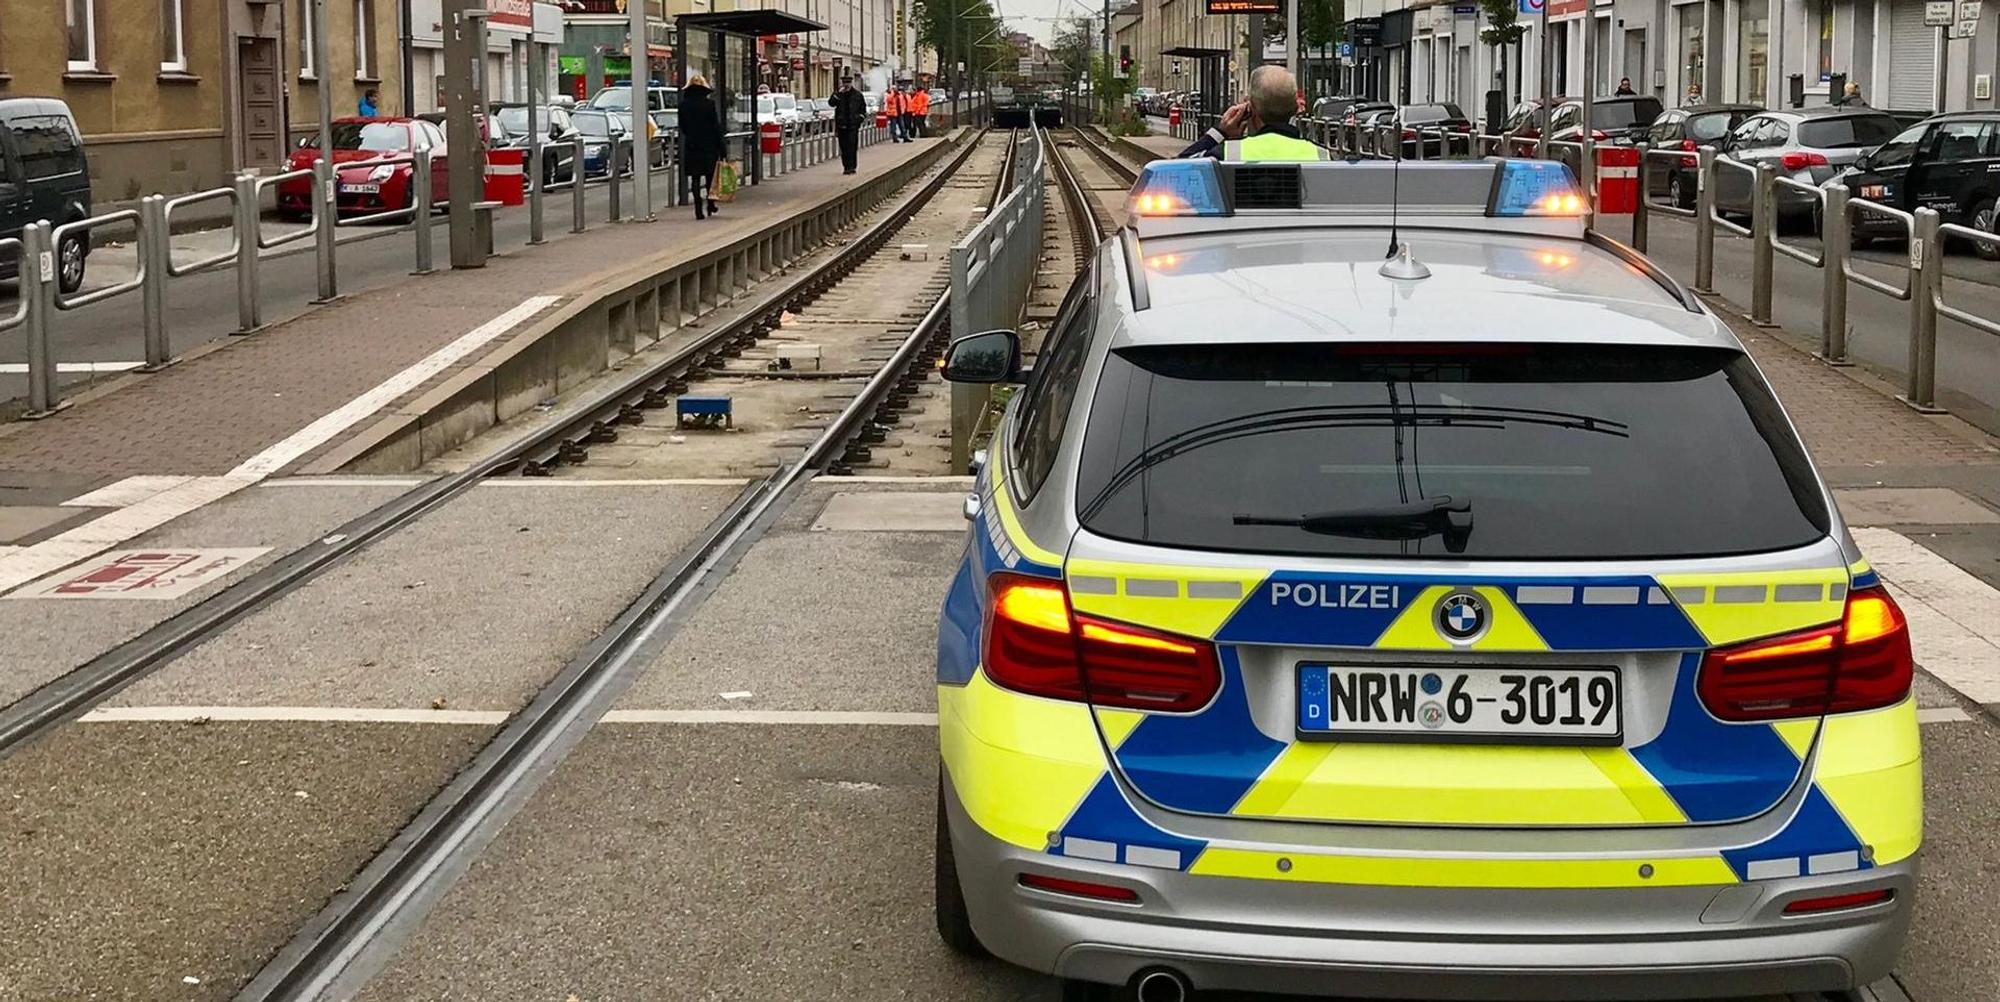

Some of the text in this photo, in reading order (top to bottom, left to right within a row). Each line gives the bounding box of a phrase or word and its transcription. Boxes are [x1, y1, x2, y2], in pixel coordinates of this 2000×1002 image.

[1172, 62, 1181, 73] H
[1861, 185, 1893, 198] RTL
[1271, 582, 1399, 609] POLIZEI
[1444, 596, 1482, 611] BMW
[1330, 673, 1614, 727] NRW 6-3019
[1309, 704, 1320, 718] D
